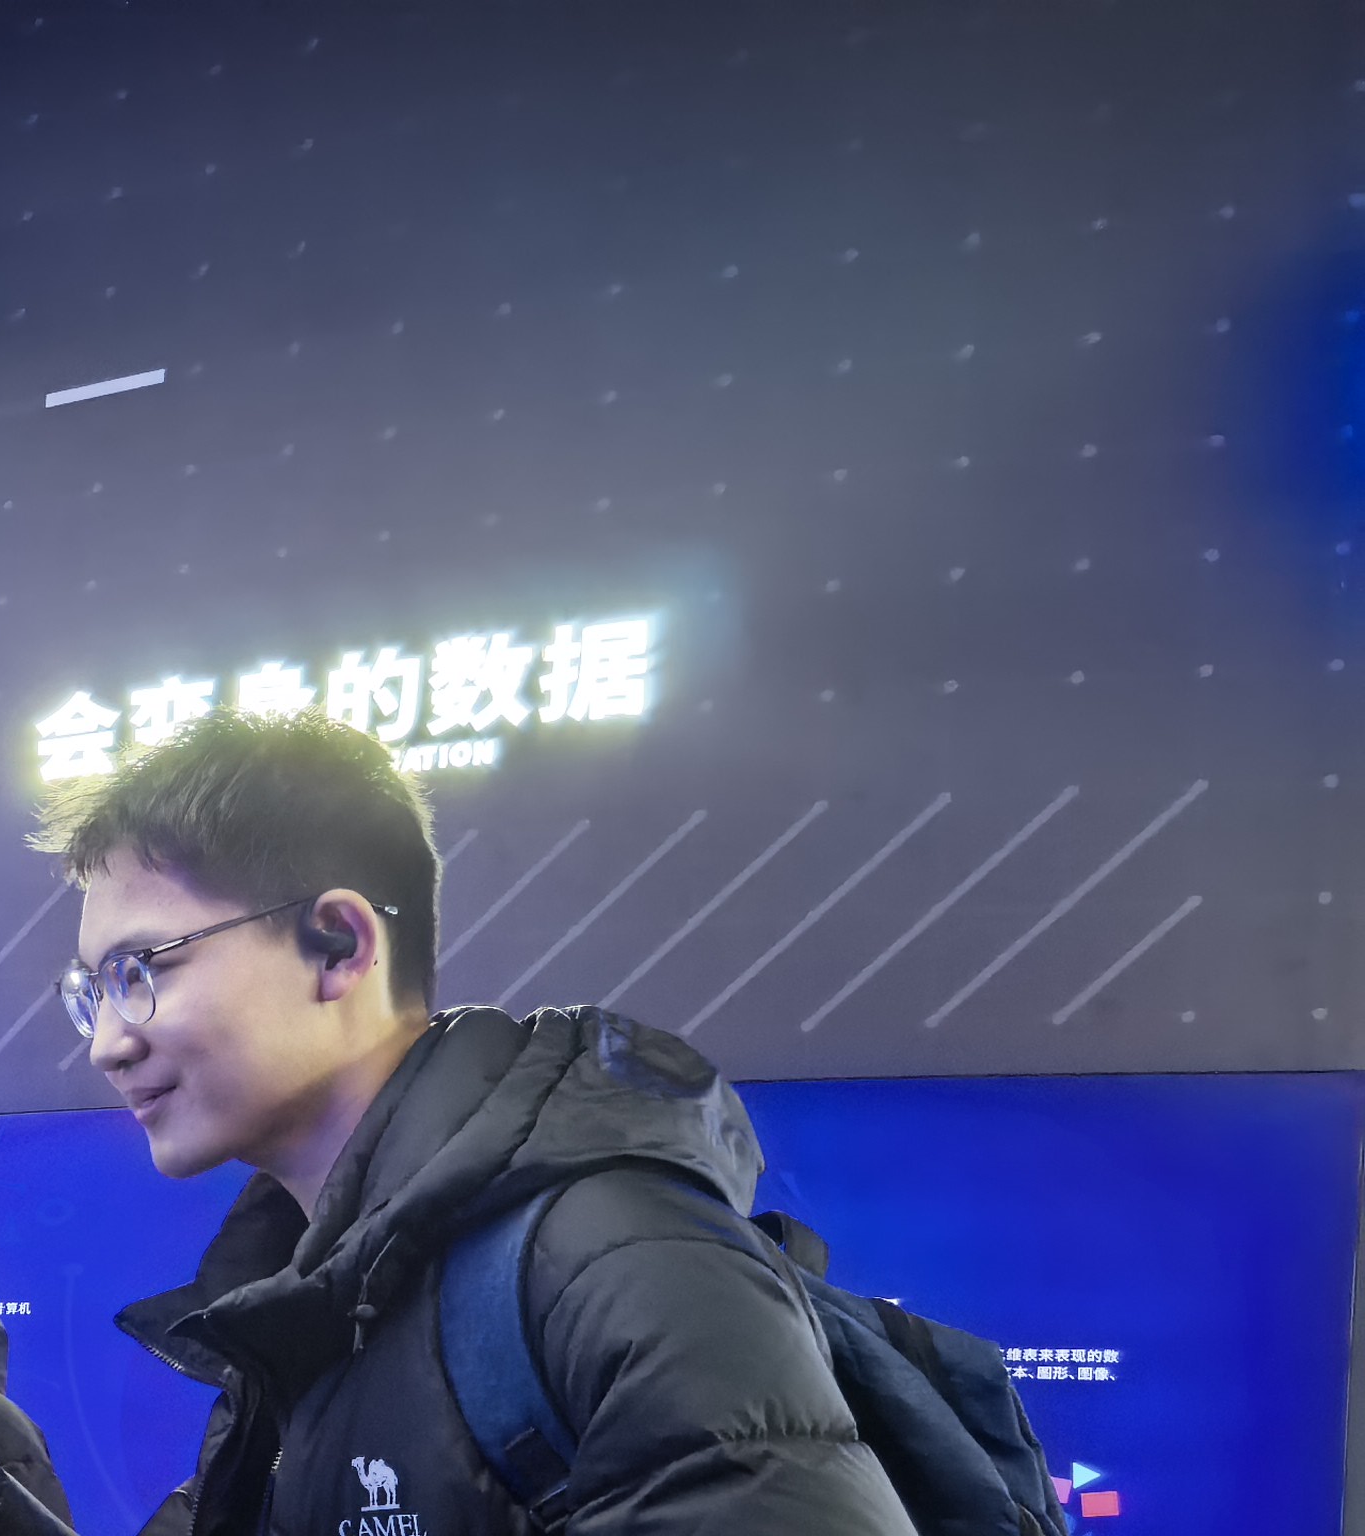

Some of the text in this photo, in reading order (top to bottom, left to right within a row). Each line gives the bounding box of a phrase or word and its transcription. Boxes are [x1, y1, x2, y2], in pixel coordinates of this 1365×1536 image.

[999, 1347, 1120, 1363] 维表来表现的数
